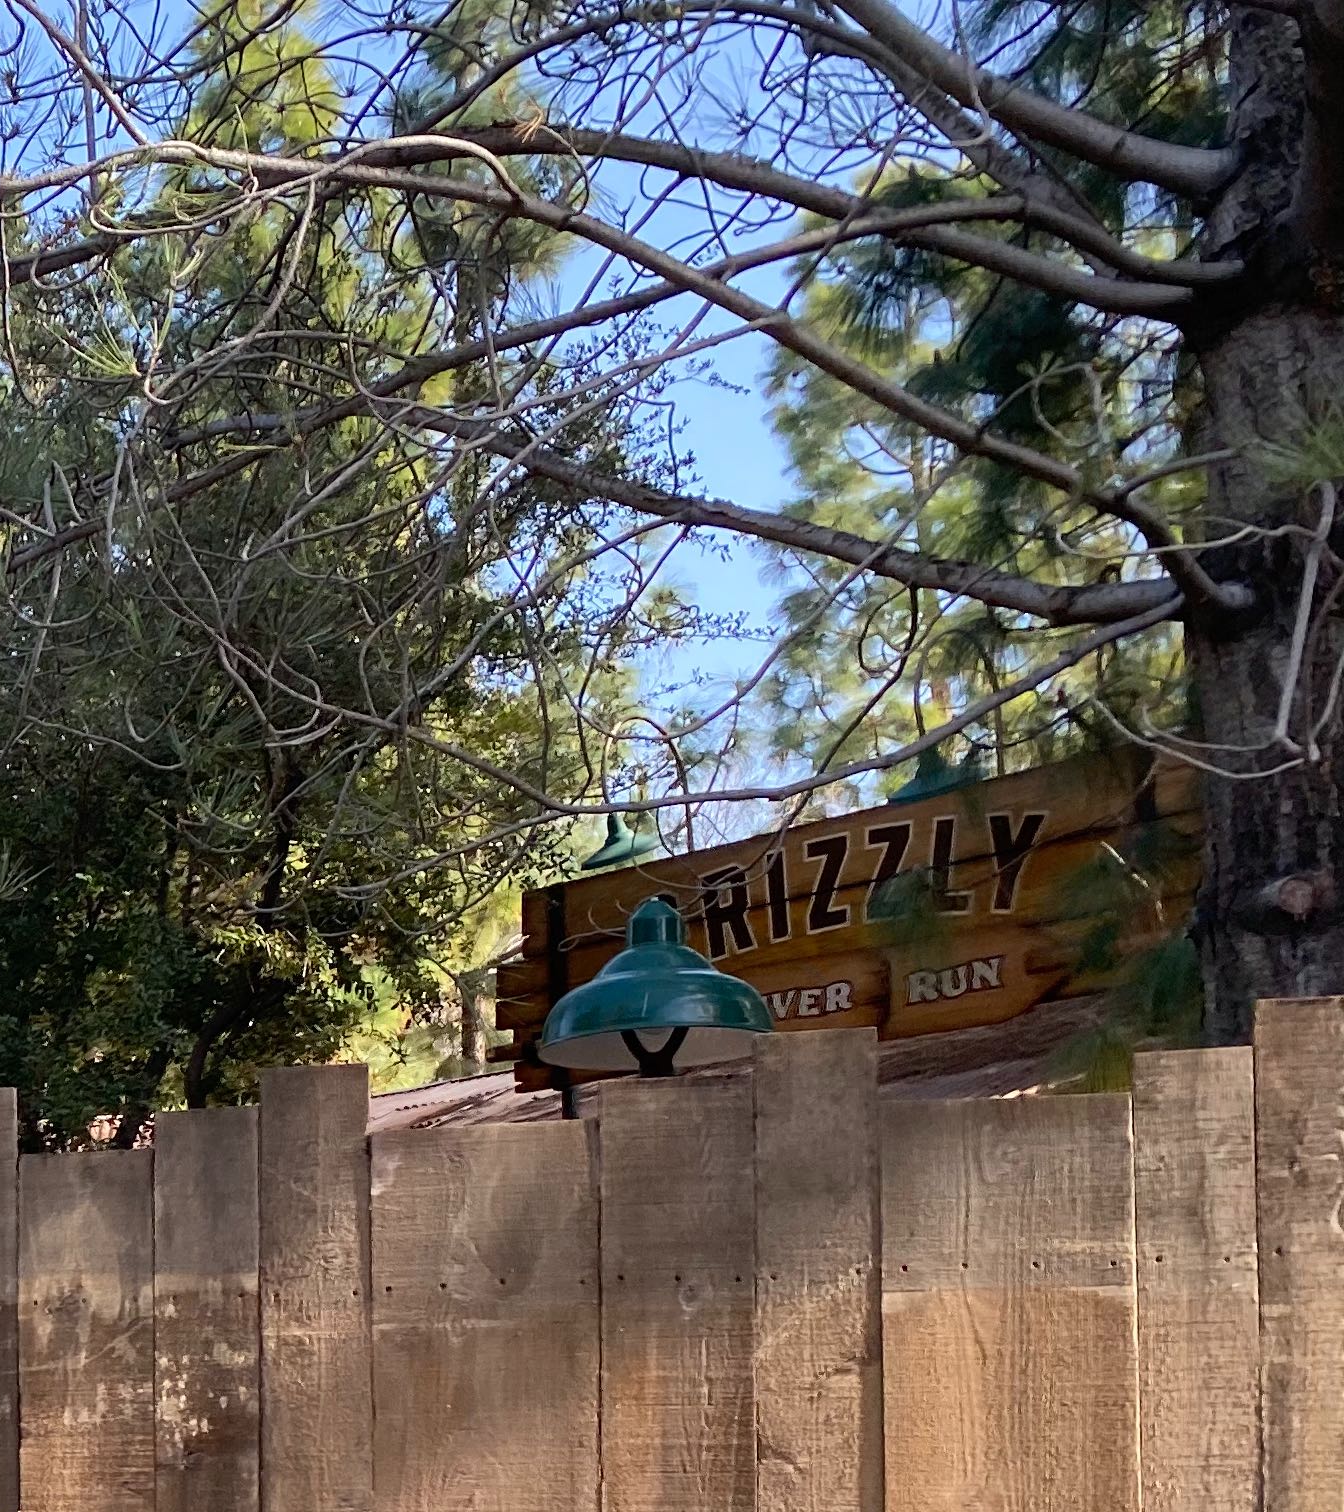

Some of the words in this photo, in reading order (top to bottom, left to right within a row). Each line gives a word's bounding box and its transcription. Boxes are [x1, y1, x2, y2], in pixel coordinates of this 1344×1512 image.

[650, 810, 1049, 962] RIZZLY
[763, 982, 853, 1019] VER
[906, 957, 1002, 1003] RUN
